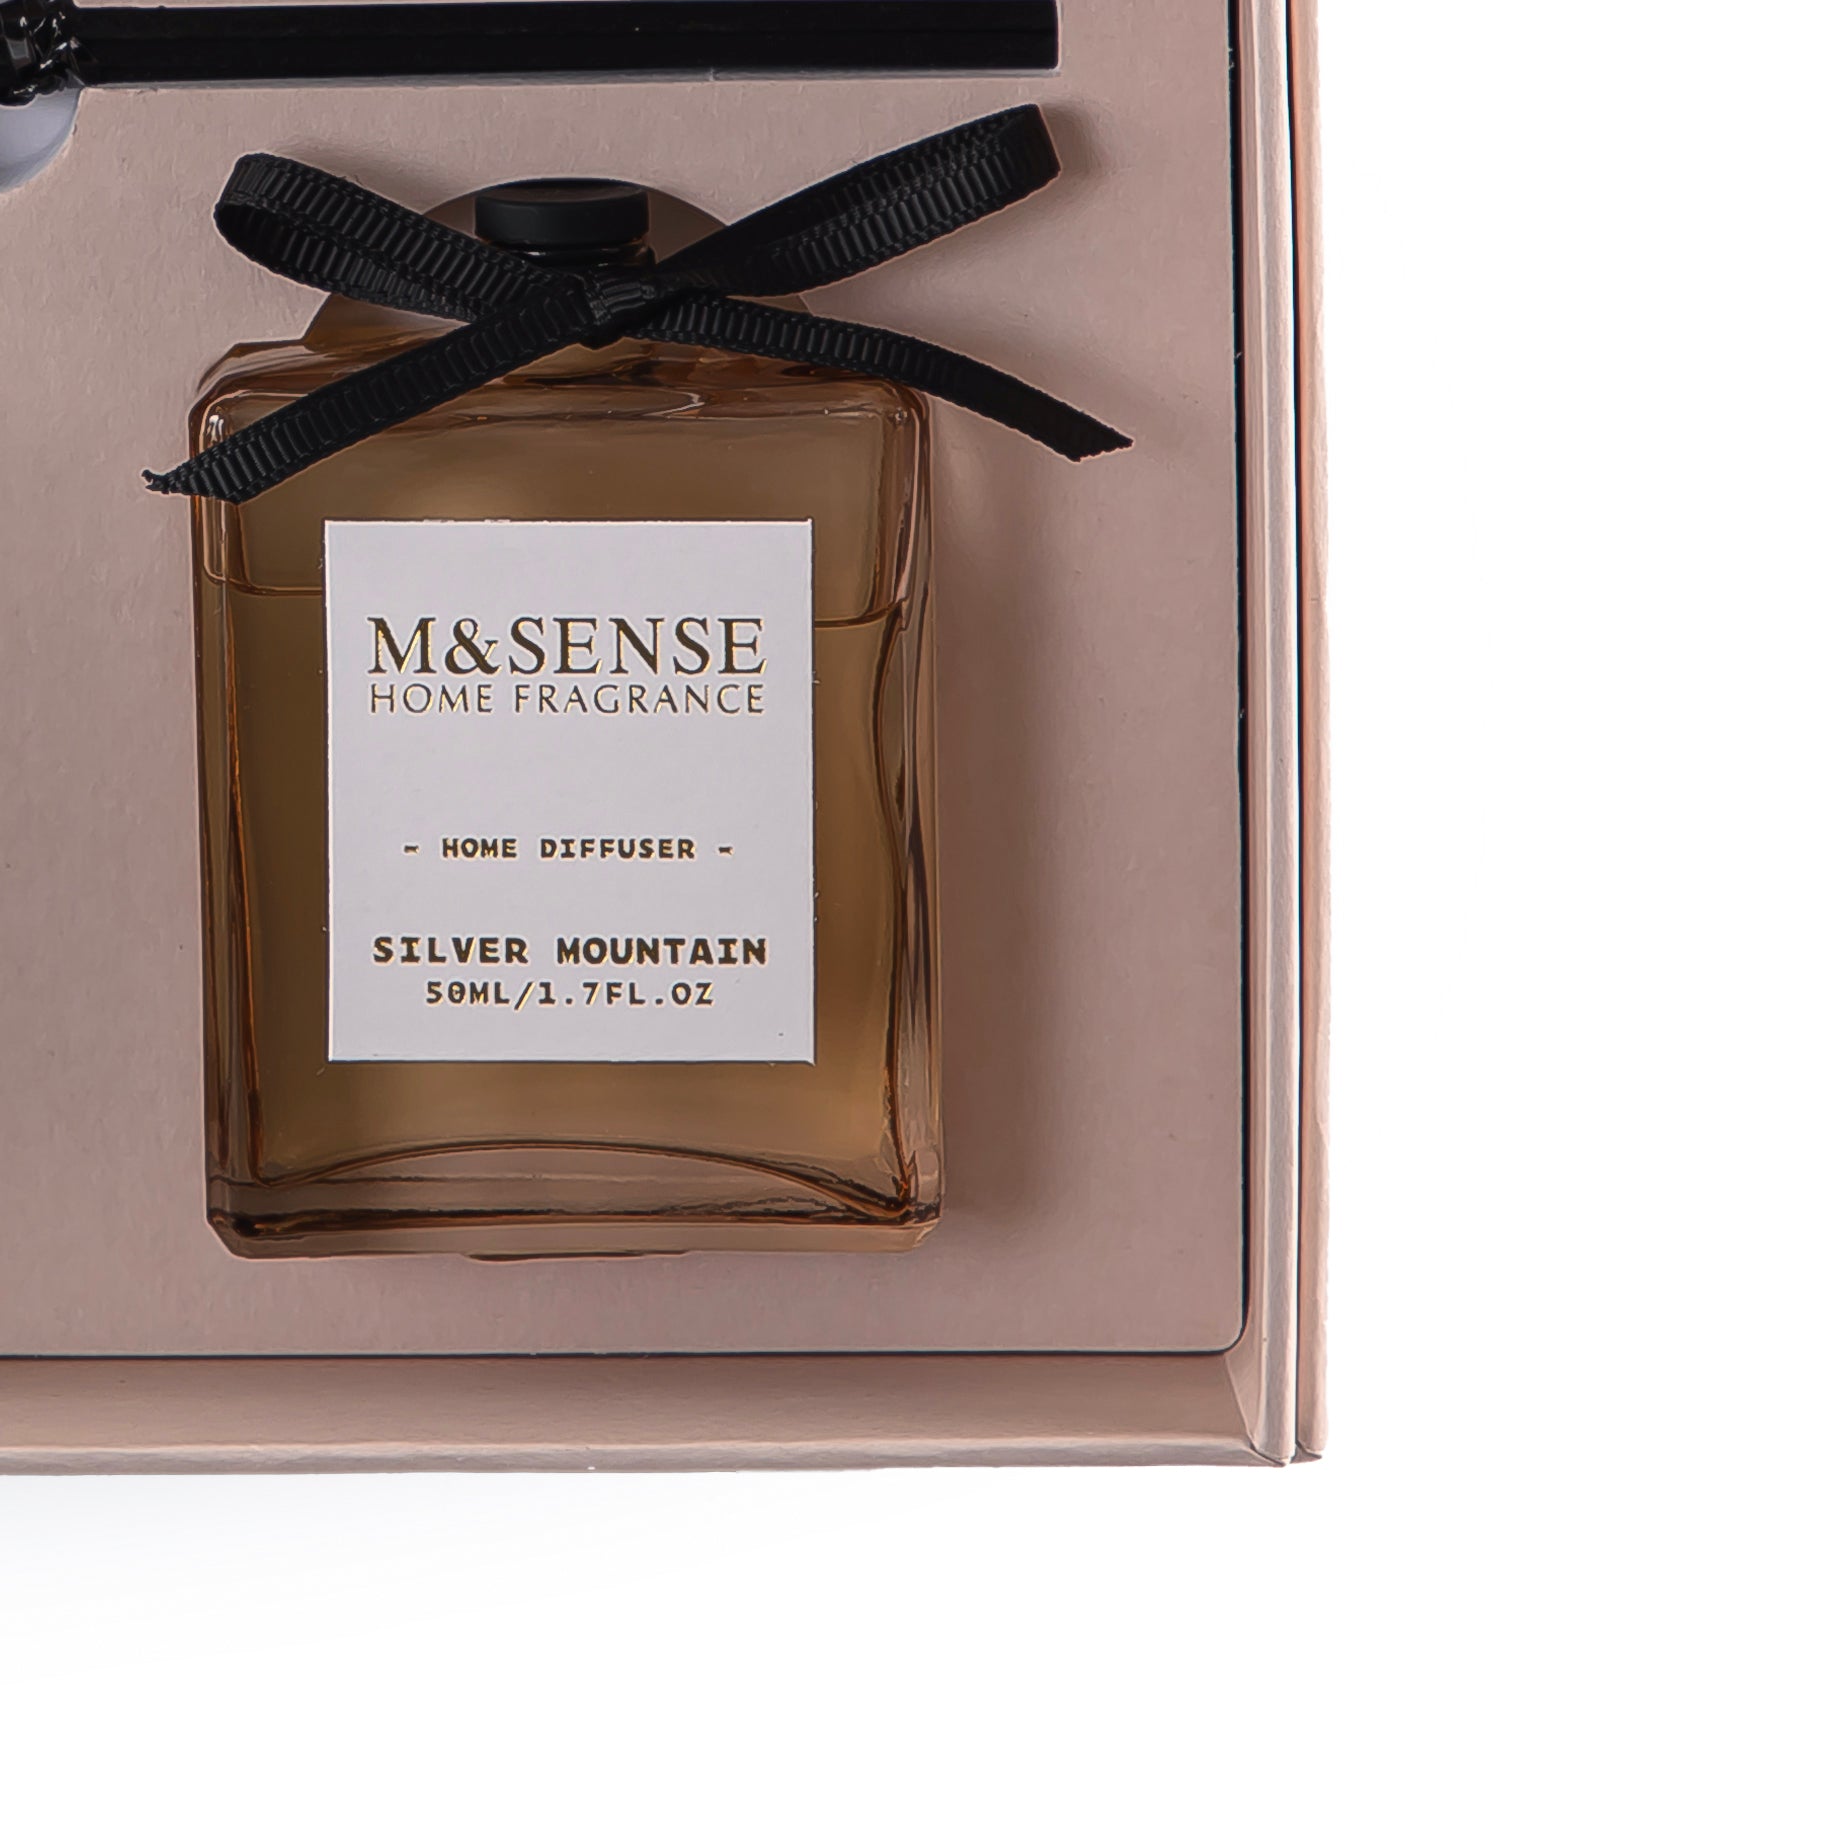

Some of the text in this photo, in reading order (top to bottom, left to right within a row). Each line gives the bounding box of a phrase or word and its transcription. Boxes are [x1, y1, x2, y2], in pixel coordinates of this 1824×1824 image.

[367, 616, 767, 676] M&SENSE
[370, 683, 766, 714] HOME FRAGRANCE
[442, 837, 518, 859] HOME
[540, 837, 696, 860] DIFFUSER
[373, 936, 768, 965] SILVER MOUNTAIN
[426, 980, 714, 1011] 50ML/1.7FL.OZ
